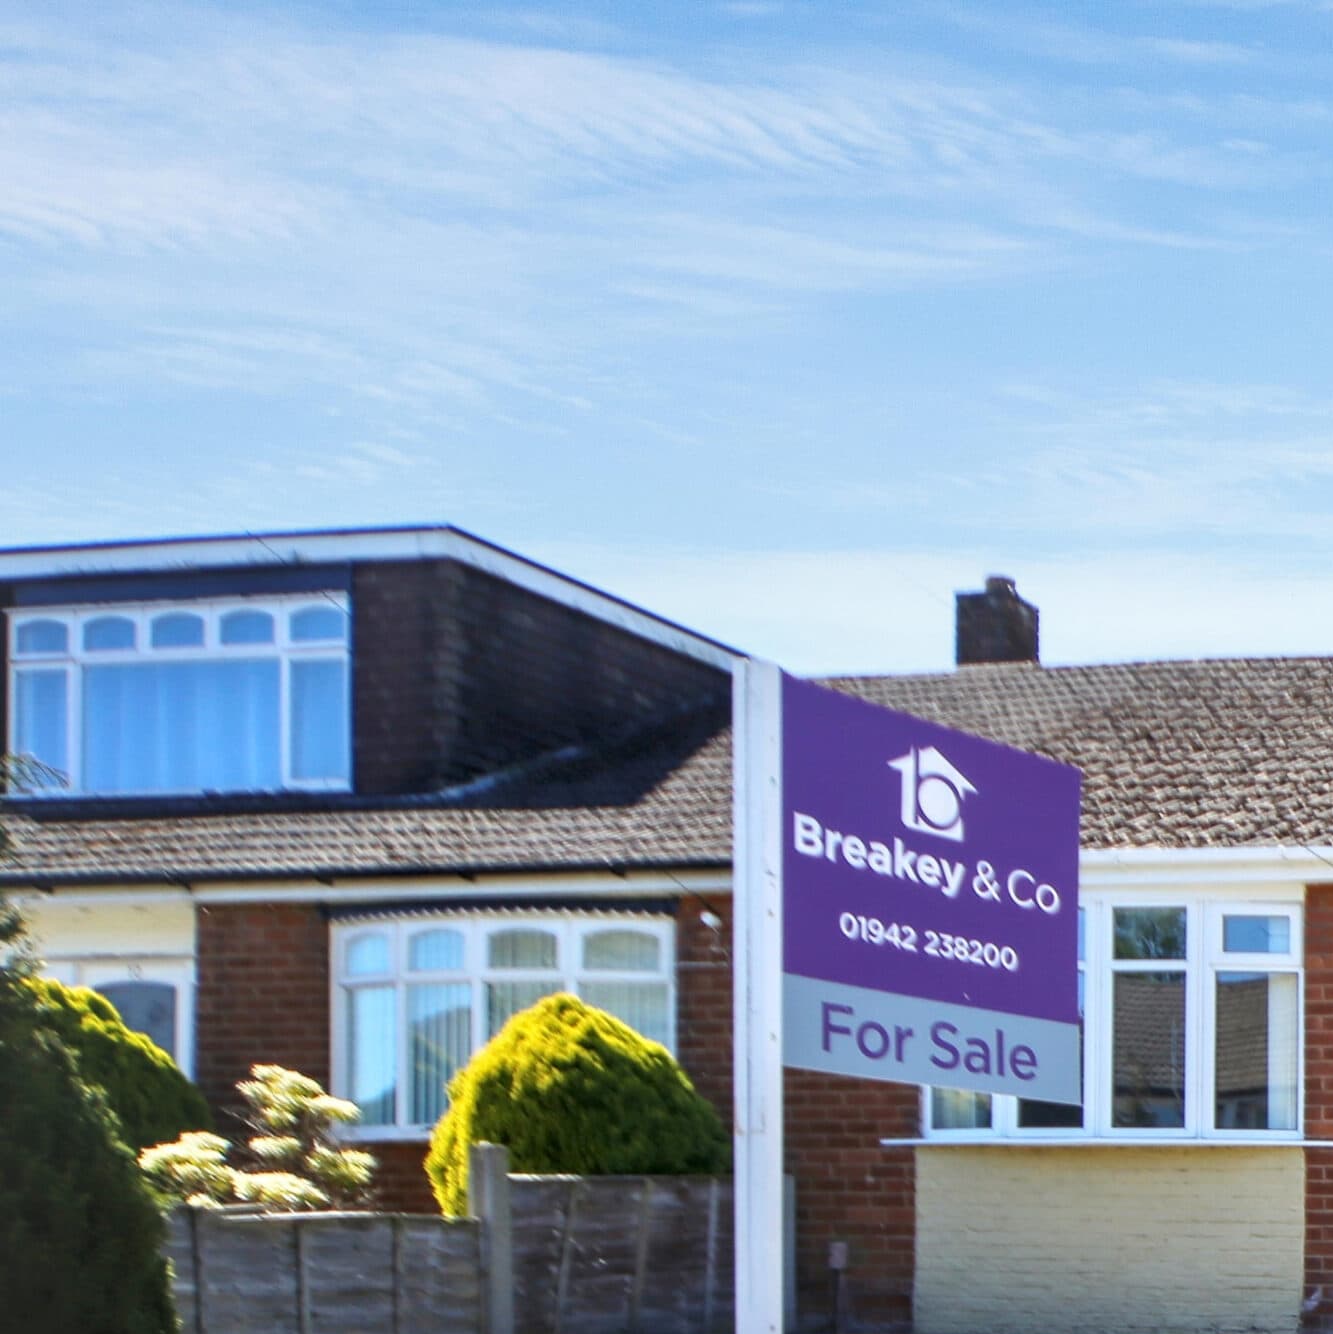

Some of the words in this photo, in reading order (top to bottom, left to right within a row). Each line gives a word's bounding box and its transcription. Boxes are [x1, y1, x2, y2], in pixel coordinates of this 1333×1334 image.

[794, 811, 965, 898] Breakey
[972, 860, 1001, 902] &
[1007, 869, 1061, 914] Co
[839, 912, 917, 952] 01942
[924, 930, 1019, 971] 238200
[821, 1001, 914, 1063] For
[929, 1021, 1038, 1081] Sale
